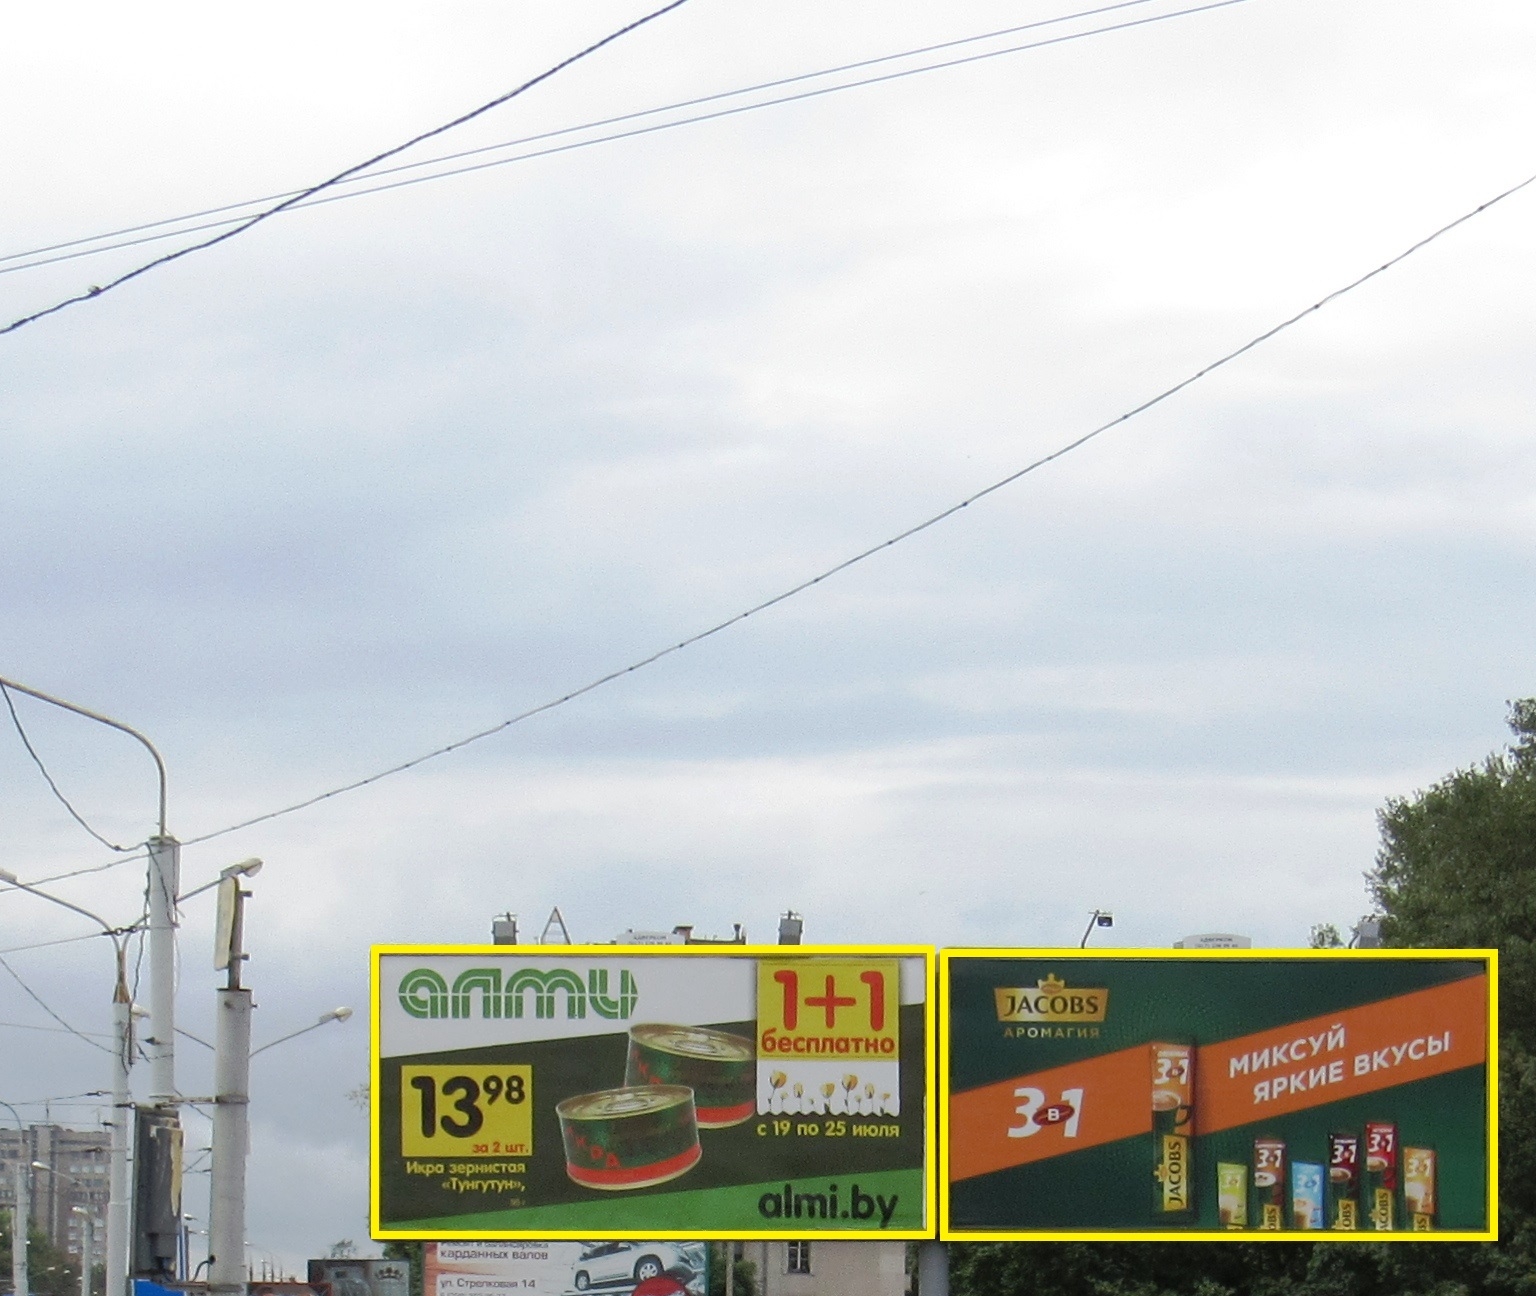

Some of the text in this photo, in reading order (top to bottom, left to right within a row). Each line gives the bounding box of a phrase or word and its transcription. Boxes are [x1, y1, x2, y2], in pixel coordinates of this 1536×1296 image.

[774, 970, 886, 1032] 1+1
[1004, 994, 1101, 1017] JACOBS
[761, 1027, 895, 1054] бесплатно
[1003, 1026, 1100, 1038] АРОМАГИЯ
[1228, 1023, 1347, 1079] МИКСУЙ
[1253, 1031, 1451, 1105] ЯРКИЕ ВКУСЫ
[773, 1121, 792, 1137] 19
[797, 1126, 819, 1137] по
[825, 1121, 846, 1137] 25
[852, 1125, 900, 1137] июля
[472, 1142, 530, 1155] за 2 шт.
[406, 1161, 527, 1177] Икра зернистая
[1168, 1140, 1184, 1207] JACOBS
[757, 1184, 899, 1228] almi.by
[440, 1250, 549, 1260] карданных валов
[522, 1279, 536, 1288] 14
